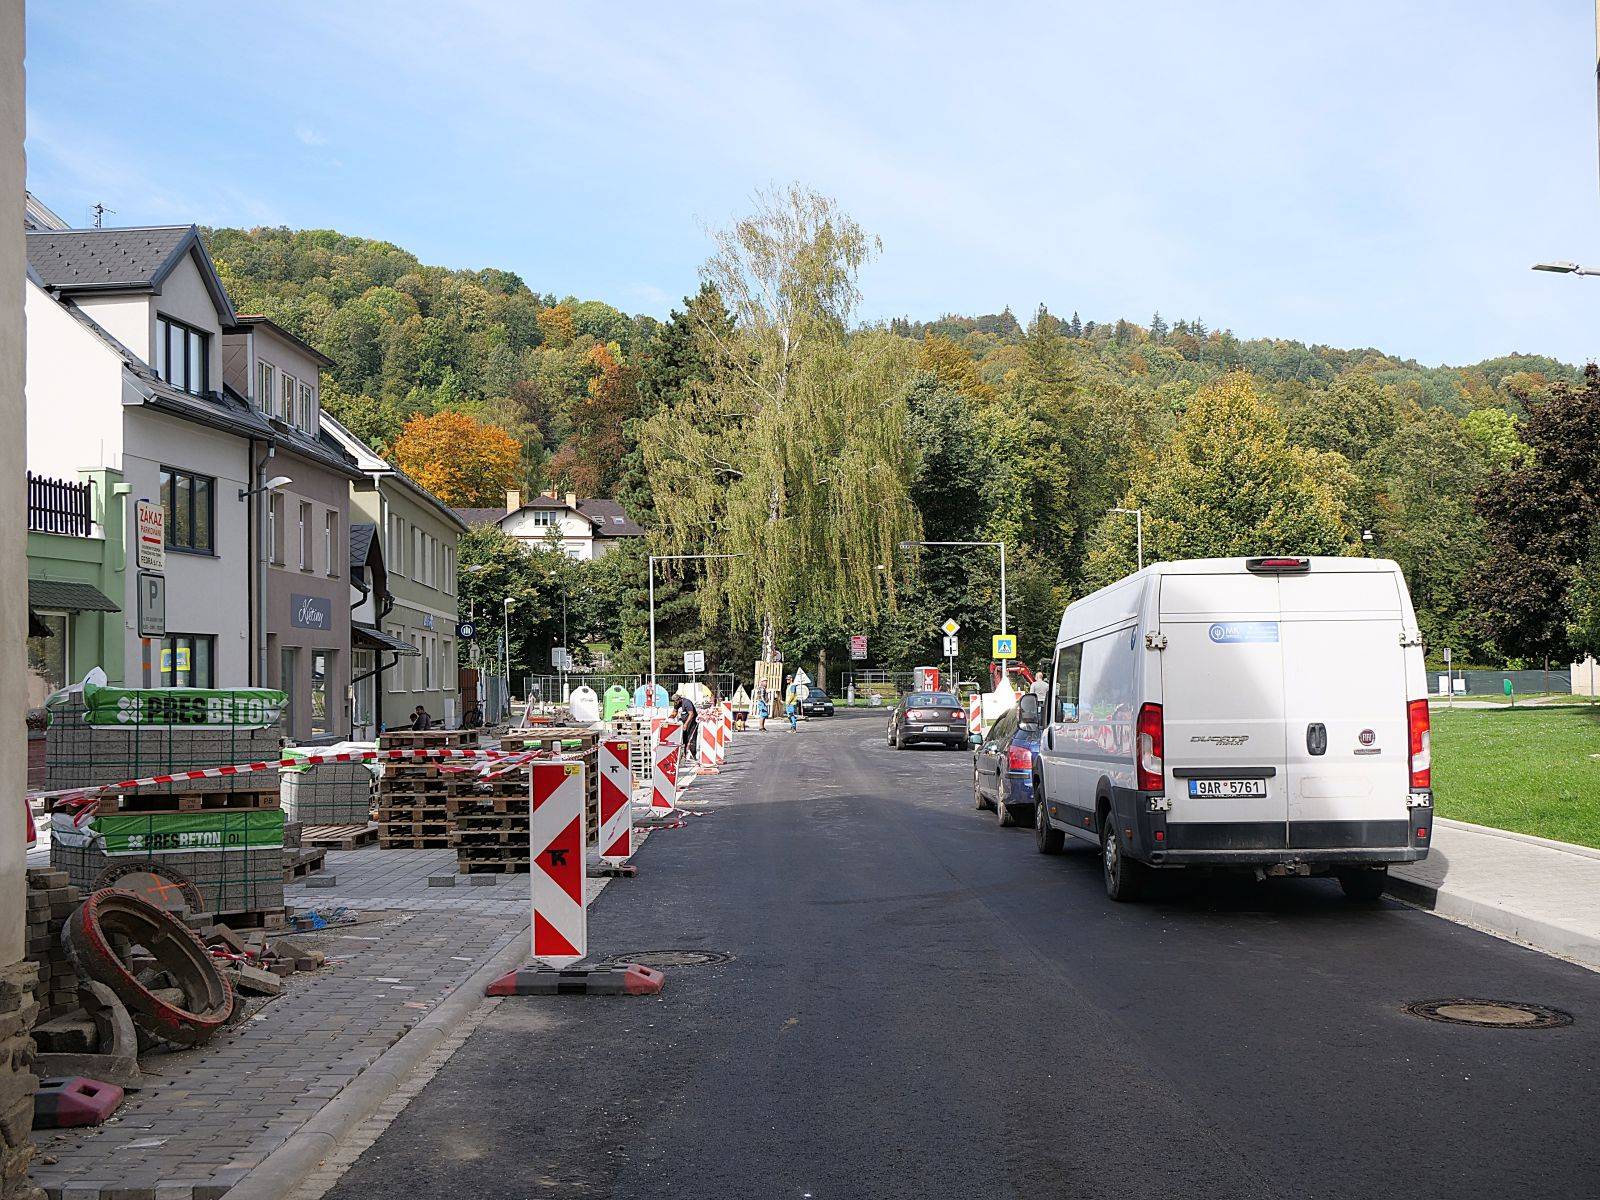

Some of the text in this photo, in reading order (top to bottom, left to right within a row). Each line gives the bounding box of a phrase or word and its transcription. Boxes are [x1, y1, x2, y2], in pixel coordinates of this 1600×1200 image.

[140, 505, 163, 527] ZÁKAZ
[149, 579, 158, 609] P
[147, 696, 278, 724] PRESBETON
[1199, 781, 1259, 794] 9AR 5761
[144, 831, 221, 850] PRESBETON
